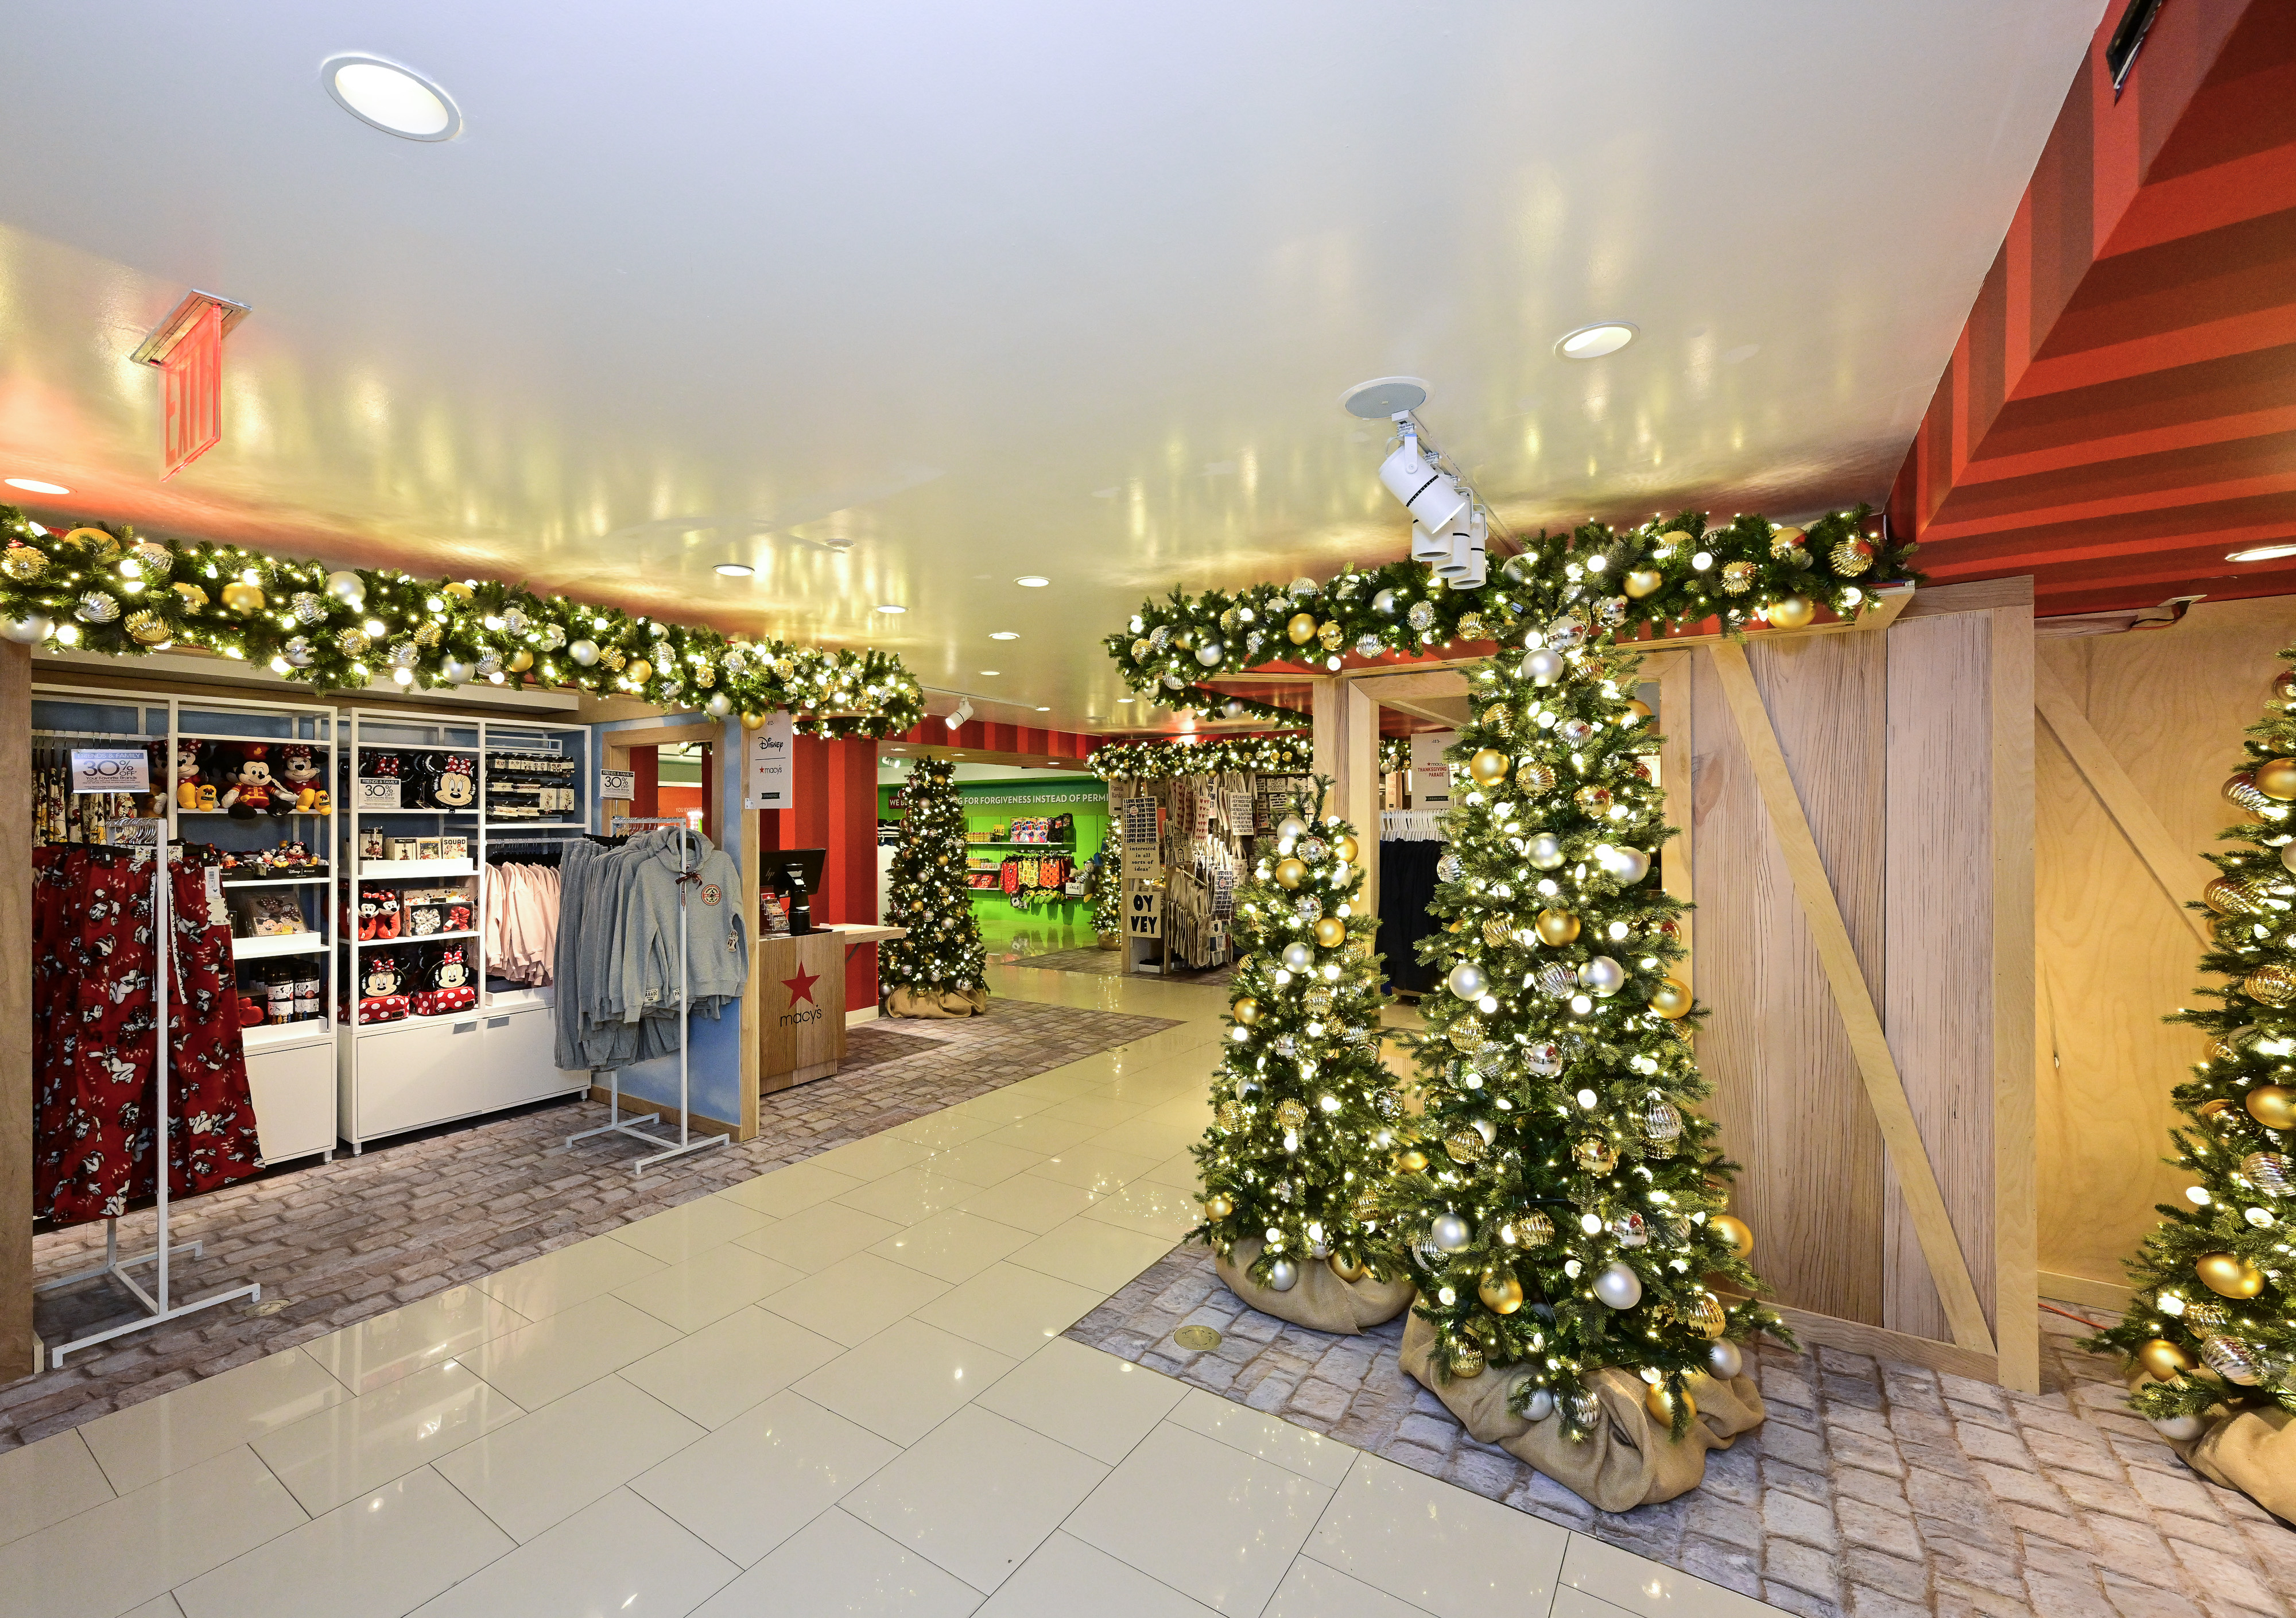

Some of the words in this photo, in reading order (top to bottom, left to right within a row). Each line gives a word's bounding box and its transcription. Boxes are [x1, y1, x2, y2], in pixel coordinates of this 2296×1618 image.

[758, 737, 784, 752] Disney
[83, 760, 134, 776] 30%
[765, 765, 782, 775] macy's
[604, 776, 629, 788] 30%
[364, 785, 393, 796] 30%
[980, 796, 1031, 804] FORGIVENESS
[1033, 795, 1067, 803] INSTEAD
[1069, 794, 1080, 803] OF
[1134, 895, 1153, 912] OY
[1130, 916, 1157, 934] VEY
[780, 1004, 822, 1027] macy's
